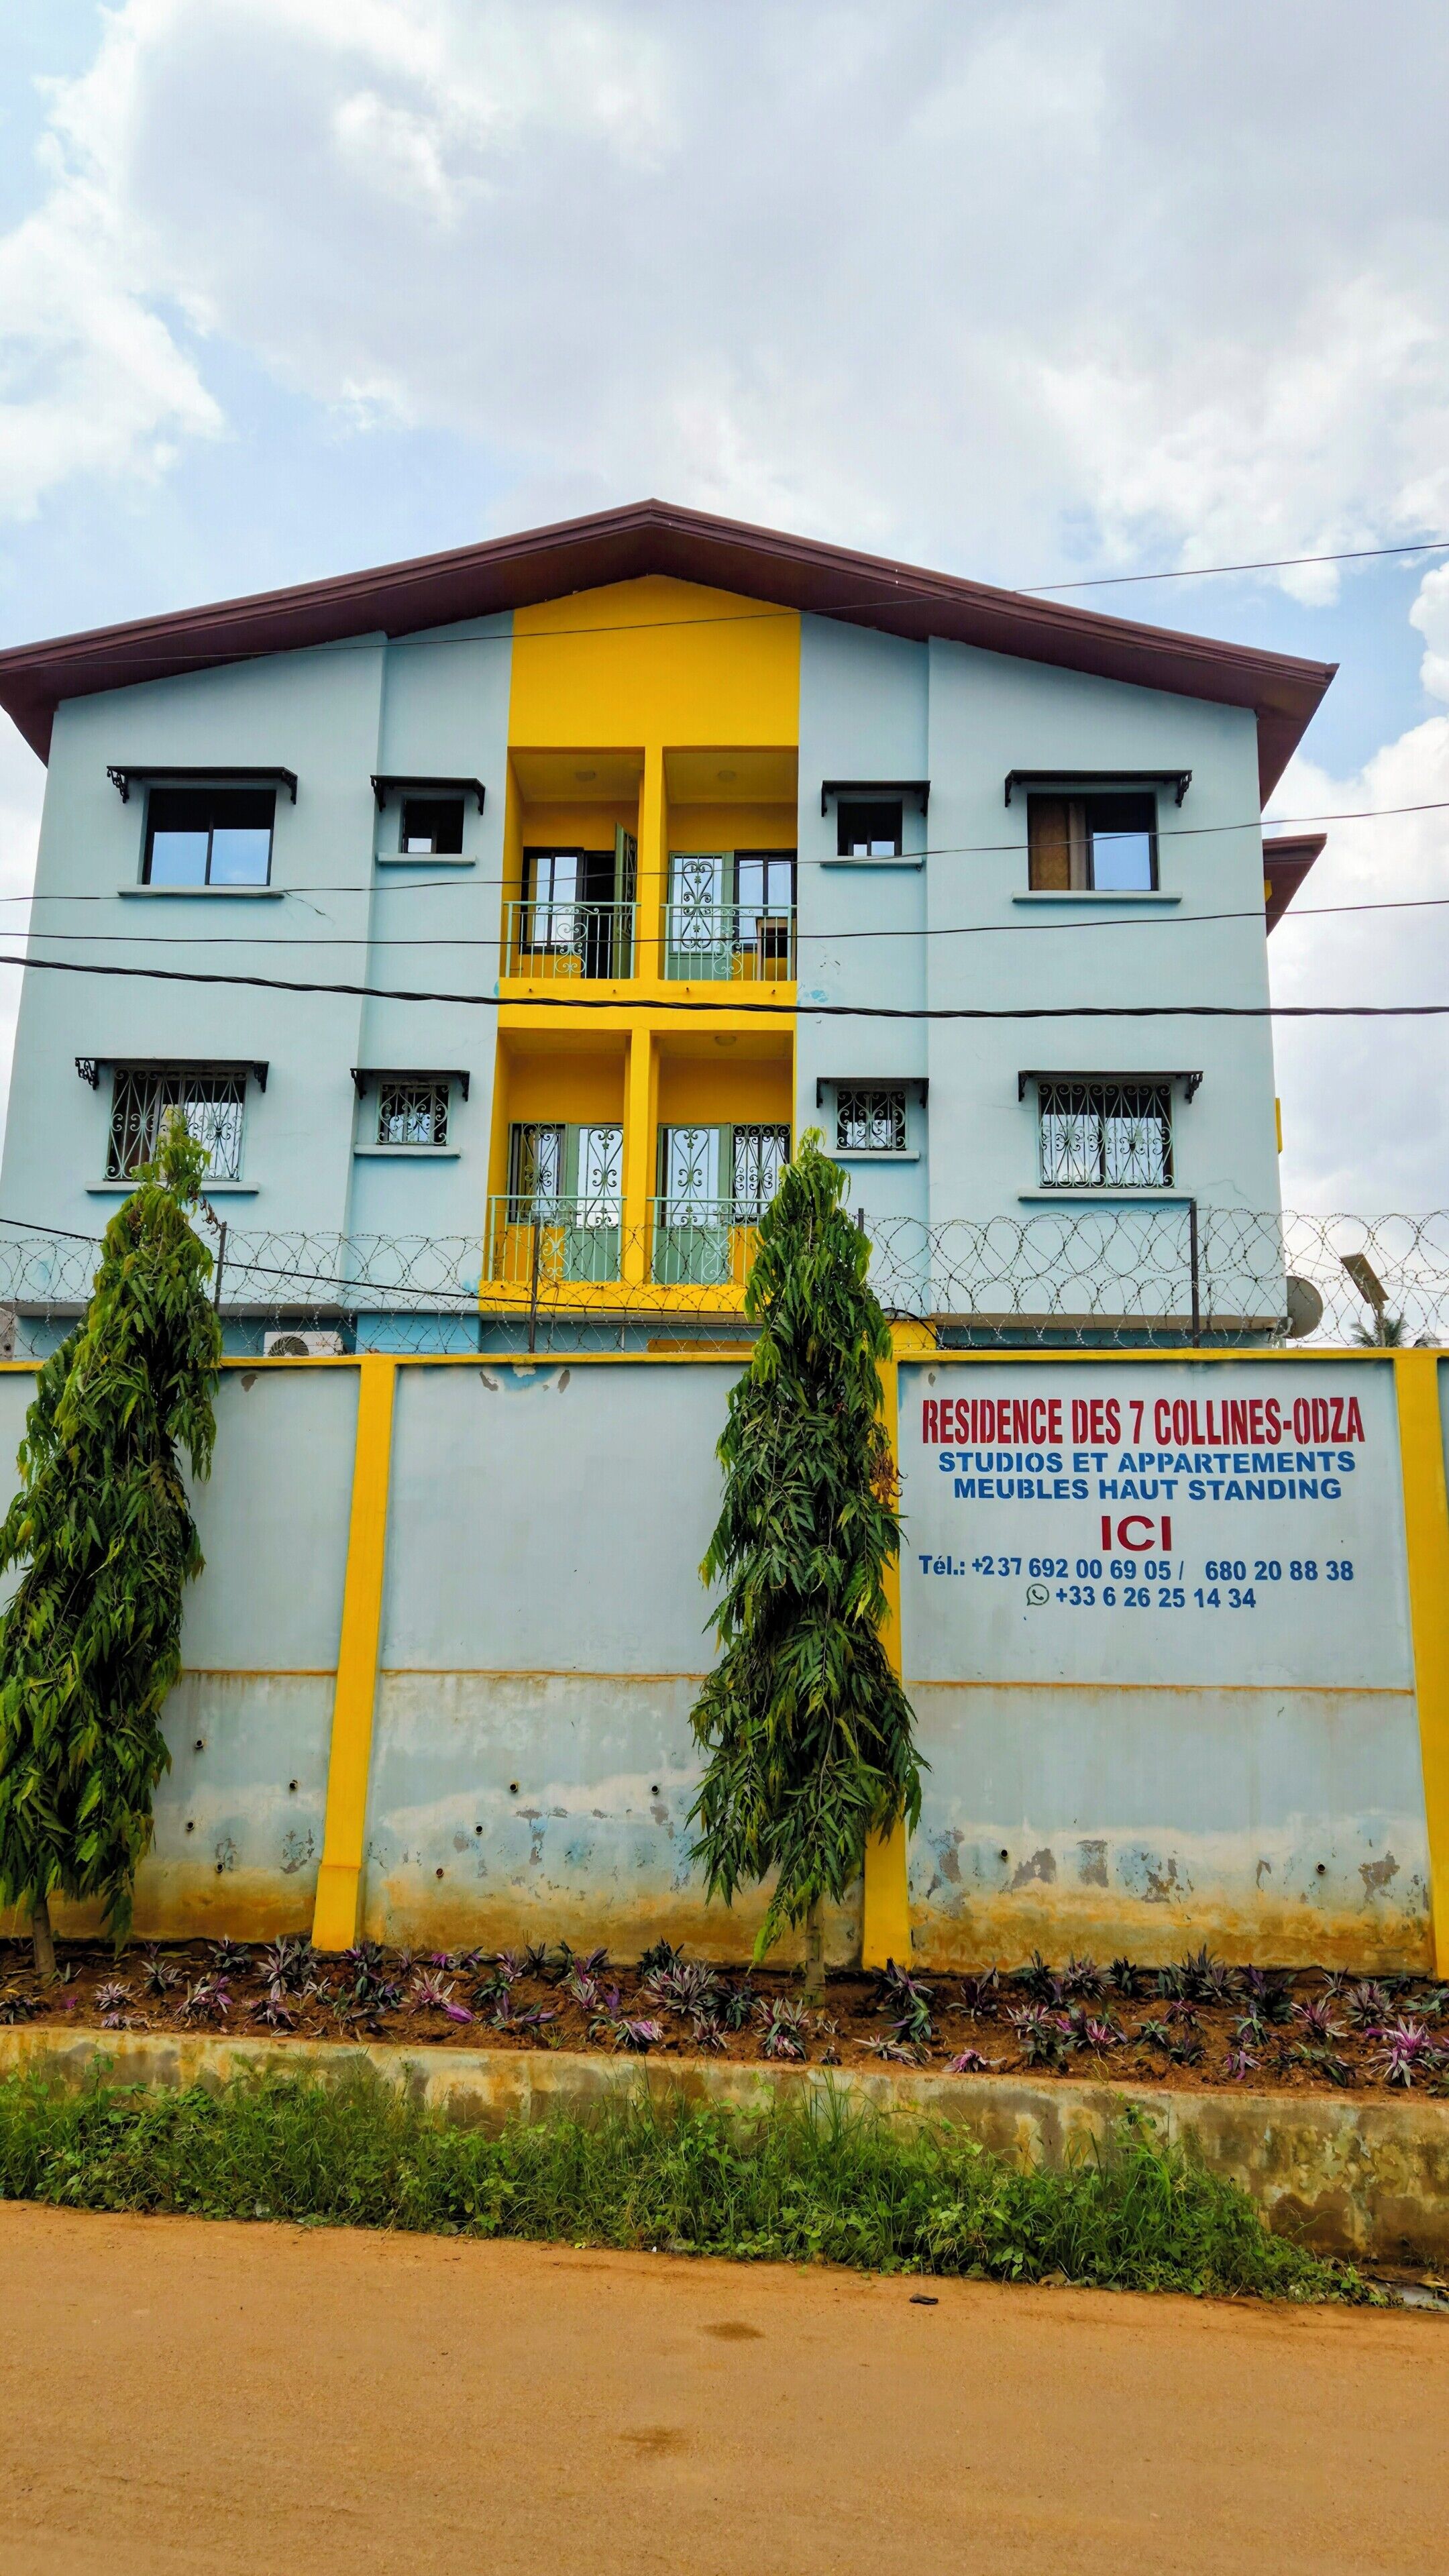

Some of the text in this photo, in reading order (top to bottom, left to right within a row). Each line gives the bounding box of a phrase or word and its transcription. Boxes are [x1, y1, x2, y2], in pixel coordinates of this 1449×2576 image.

[922, 1397, 1364, 1445] RESIDENCE DES 7 COLLINES-ODZA
[938, 1450, 1355, 1473] STUDIOS ET APPARTEMENTS
[954, 1478, 1341, 1500] MEUBLES HAUT STANDING
[1102, 1515, 1171, 1551] ICI
[918, 1555, 964, 1575] Tél.:
[971, 1555, 1021, 1576] +237
[1028, 1558, 1068, 1578] 692
[1076, 1559, 1102, 1578] 00
[1110, 1559, 1136, 1579] 69
[1144, 1560, 1171, 1580] 05
[1205, 1560, 1246, 1580] 680
[1254, 1560, 1281, 1580] 20
[1289, 1560, 1318, 1580] 88
[1326, 1560, 1352, 1580] 38
[1056, 1585, 1256, 1608] +33 6 26 25 14 34
